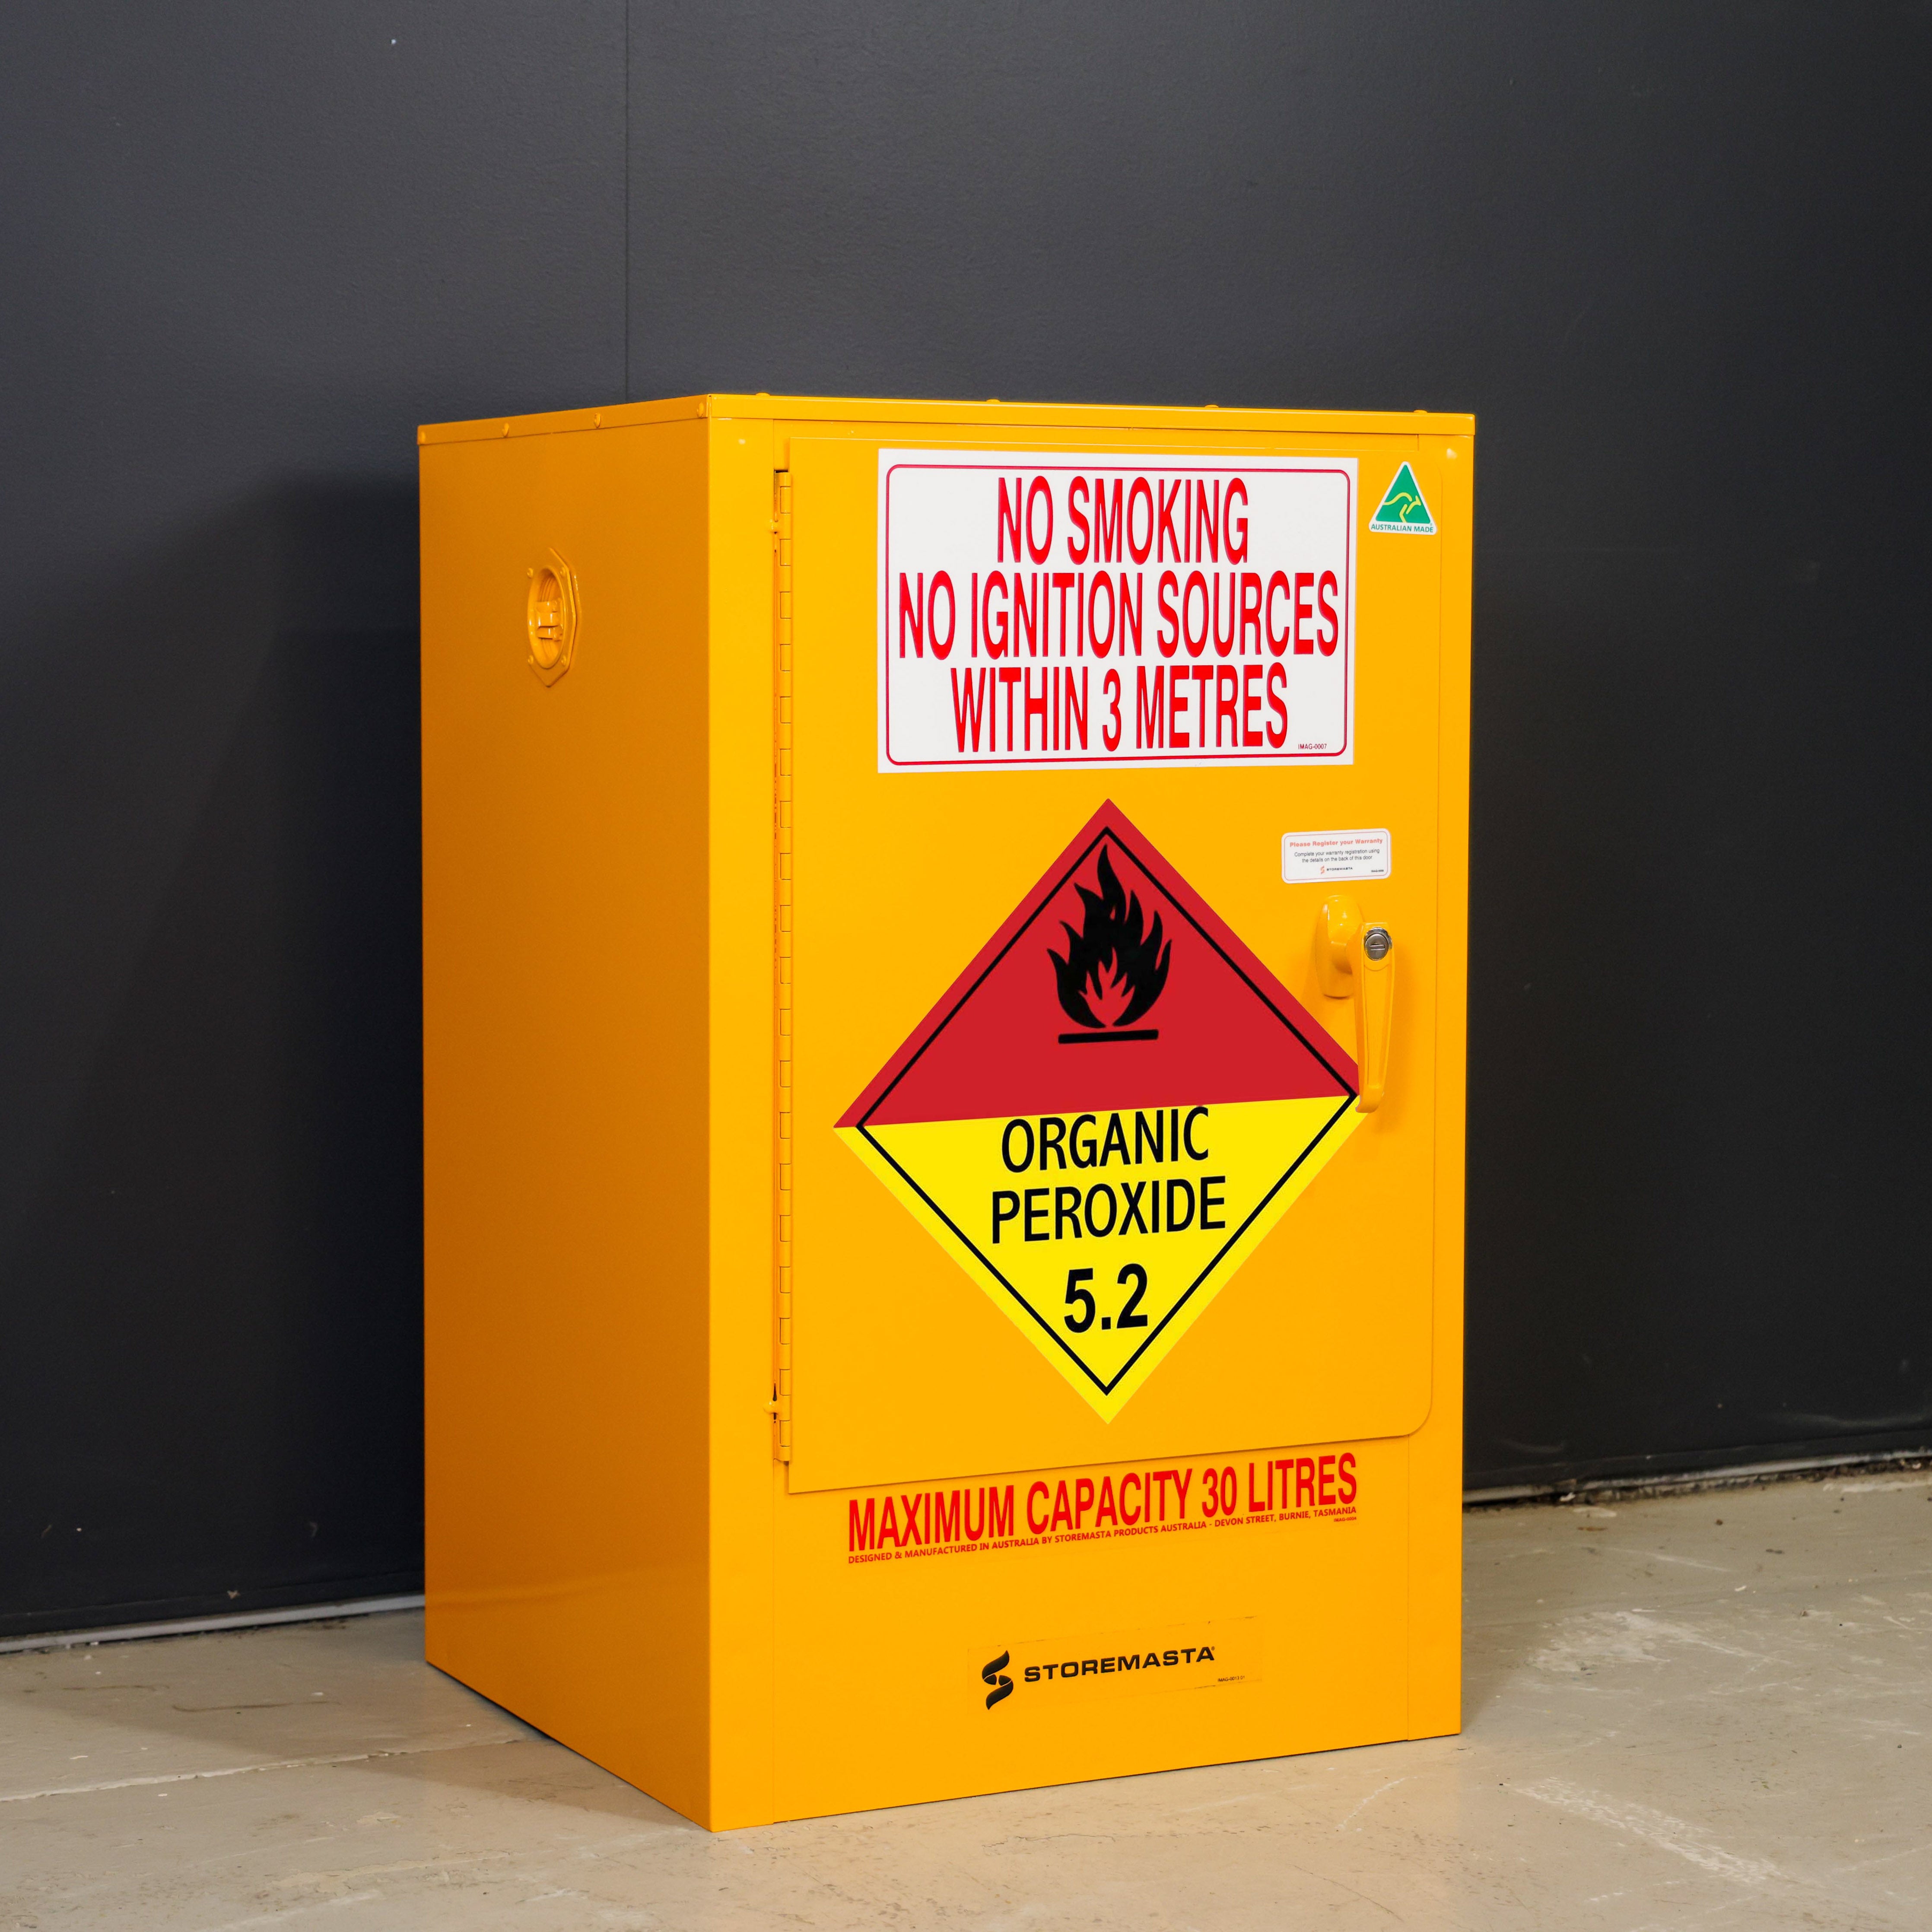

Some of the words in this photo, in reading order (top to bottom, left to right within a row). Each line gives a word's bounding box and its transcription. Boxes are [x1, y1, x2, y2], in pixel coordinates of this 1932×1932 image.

[997, 476, 1052, 565] NO
[1067, 476, 1248, 565] SMOKING
[899, 570, 955, 660] NO
[971, 570, 1142, 660] IGNITION
[1157, 570, 1338, 658] SOURCES
[950, 666, 1087, 753] WITHIN
[1102, 669, 1122, 751] 3
[1136, 662, 1287, 749] METRES
[1002, 1106, 1208, 1173] ORGANIC
[992, 1176, 1225, 1244] PEROXIDE
[1064, 1263, 1147, 1333] 5.2
[848, 1485, 1015, 1552] MAXIMUM
[1026, 1468, 1192, 1533] CAPACITY
[1201, 1466, 1237, 1518] 30
[1249, 1452, 1357, 1512] LITRES
[848, 1551, 892, 1563] DESIGNED
[905, 1542, 977, 1558] MANUFACTURED
[991, 1536, 1039, 1549] AUSTRALIA
[1055, 1531, 1111, 1543] STOREMASTA
[1114, 1525, 1158, 1537] PRODUCTS
[1160, 1521, 1206, 1532] AUSTRALIA
[1214, 1518, 1243, 1527] DEVON
[1246, 1514, 1277, 1524] STREET,
[1279, 1510, 1311, 1521] BURNIE,
[1313, 1506, 1357, 1517] TASMANIA
